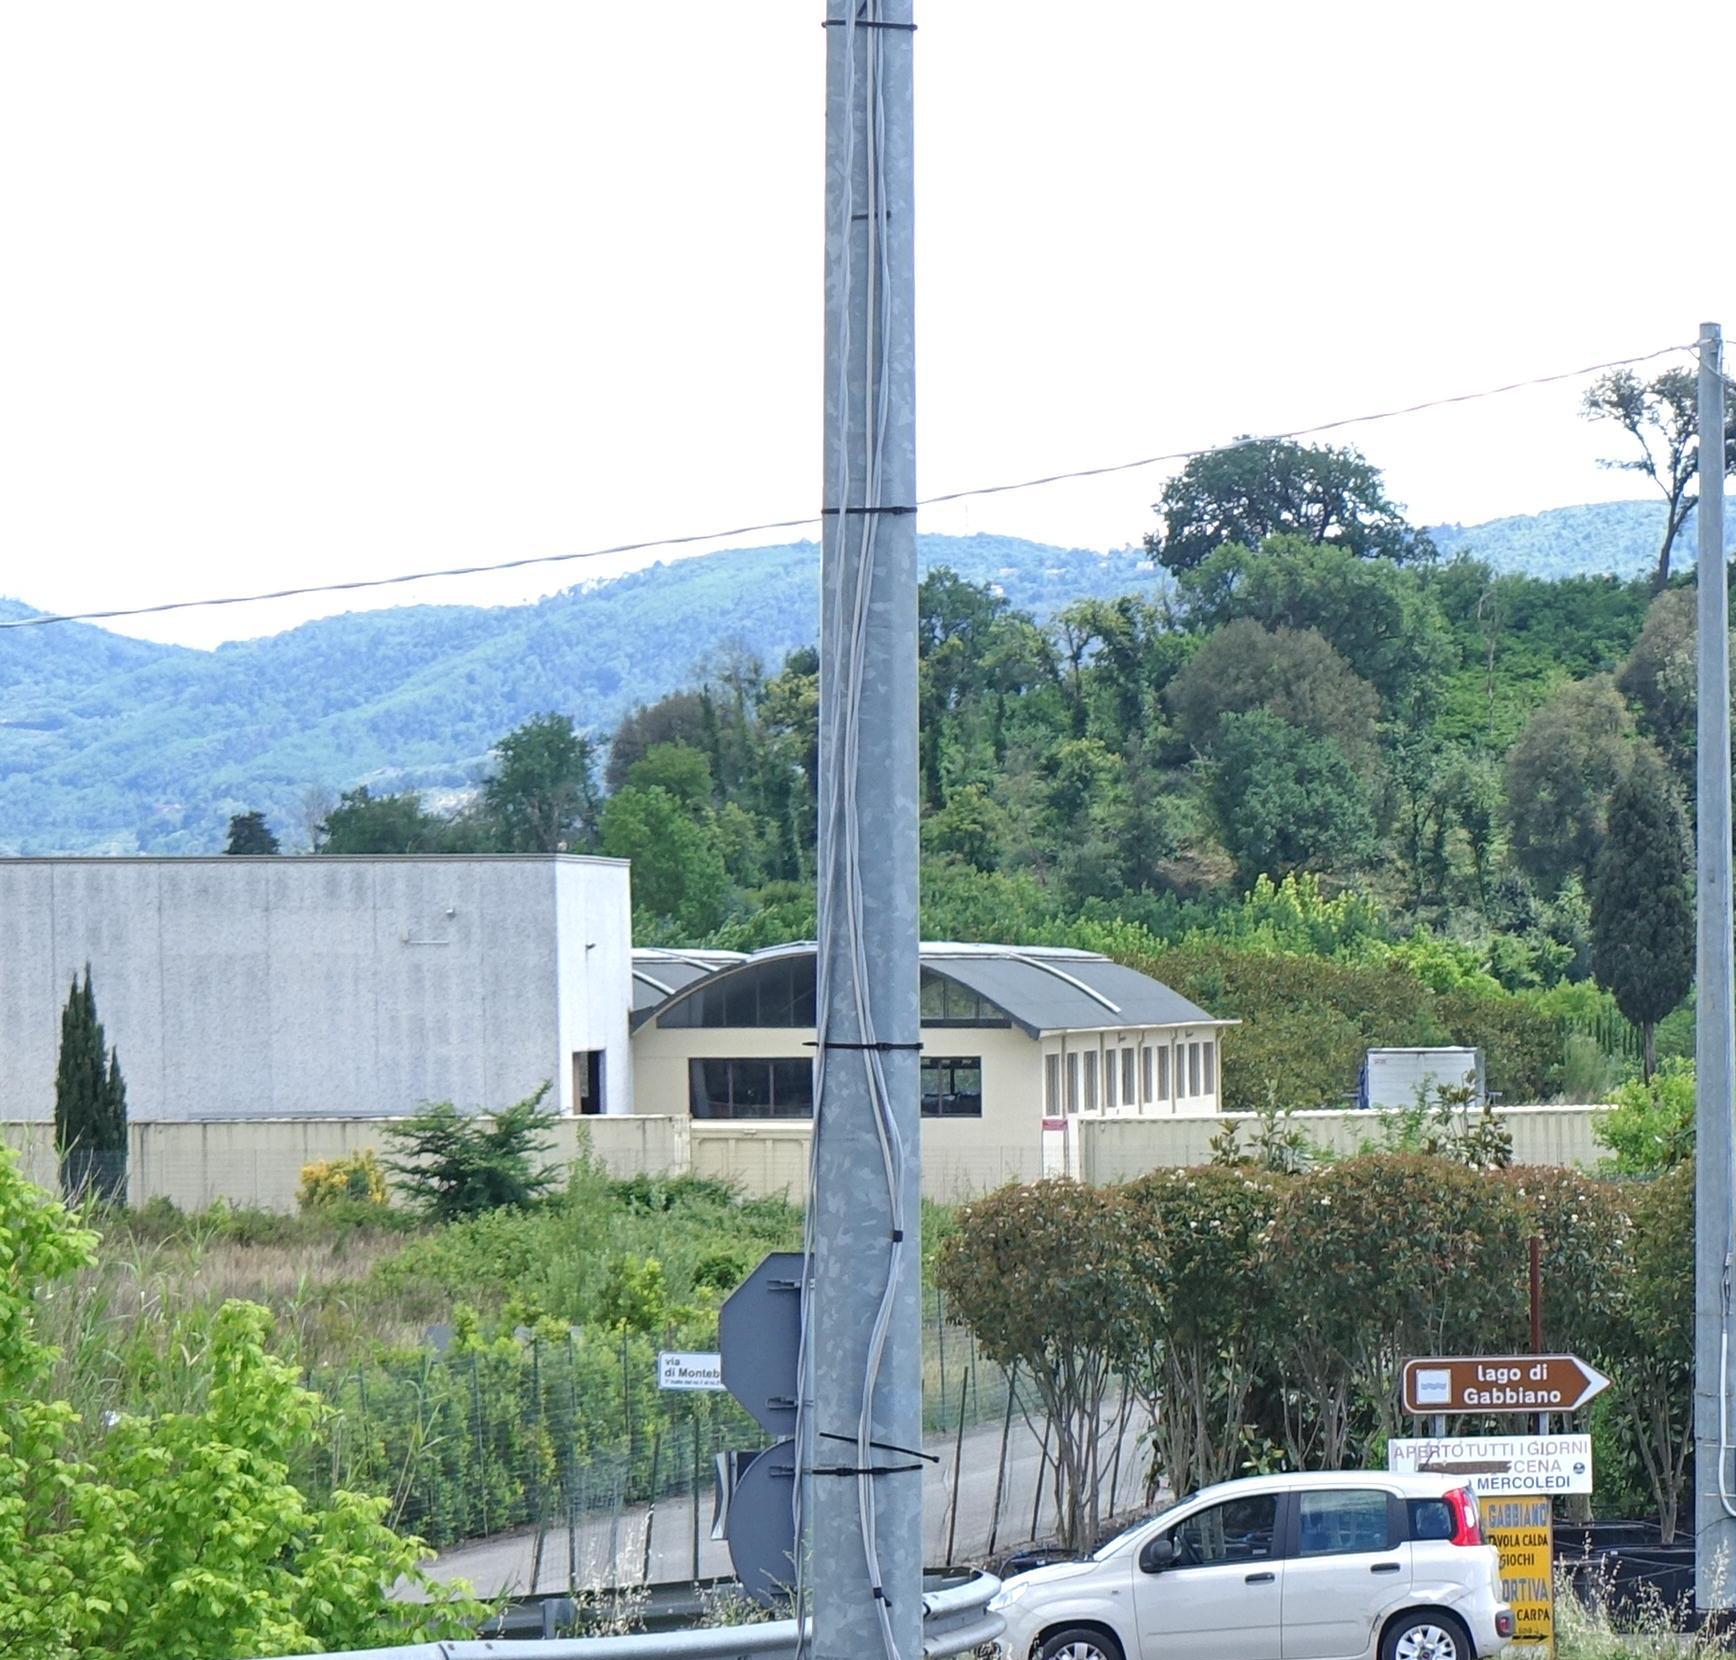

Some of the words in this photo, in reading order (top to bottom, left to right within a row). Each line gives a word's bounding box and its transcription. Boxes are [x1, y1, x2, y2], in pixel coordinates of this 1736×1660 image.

[664, 1357, 680, 1366] via
[664, 1368, 676, 1377] di
[679, 1368, 720, 1378] Monteb
[1529, 1363, 1548, 1380] di
[1463, 1387, 1562, 1404] Gabbiano
[1394, 1443, 1463, 1459] APERTO
[1465, 1443, 1514, 1457] TUTTI
[1527, 1440, 1589, 1456] GIORNI
[1513, 1459, 1562, 1473] CENA
[1488, 1534, 1520, 1547] TAVOLA
[1522, 1533, 1549, 1546] CALDA
[1499, 1554, 1535, 1569] GIOCHI
[1501, 1578, 1548, 1602] ORTIVA
[1516, 1608, 1550, 1621] CARPA
